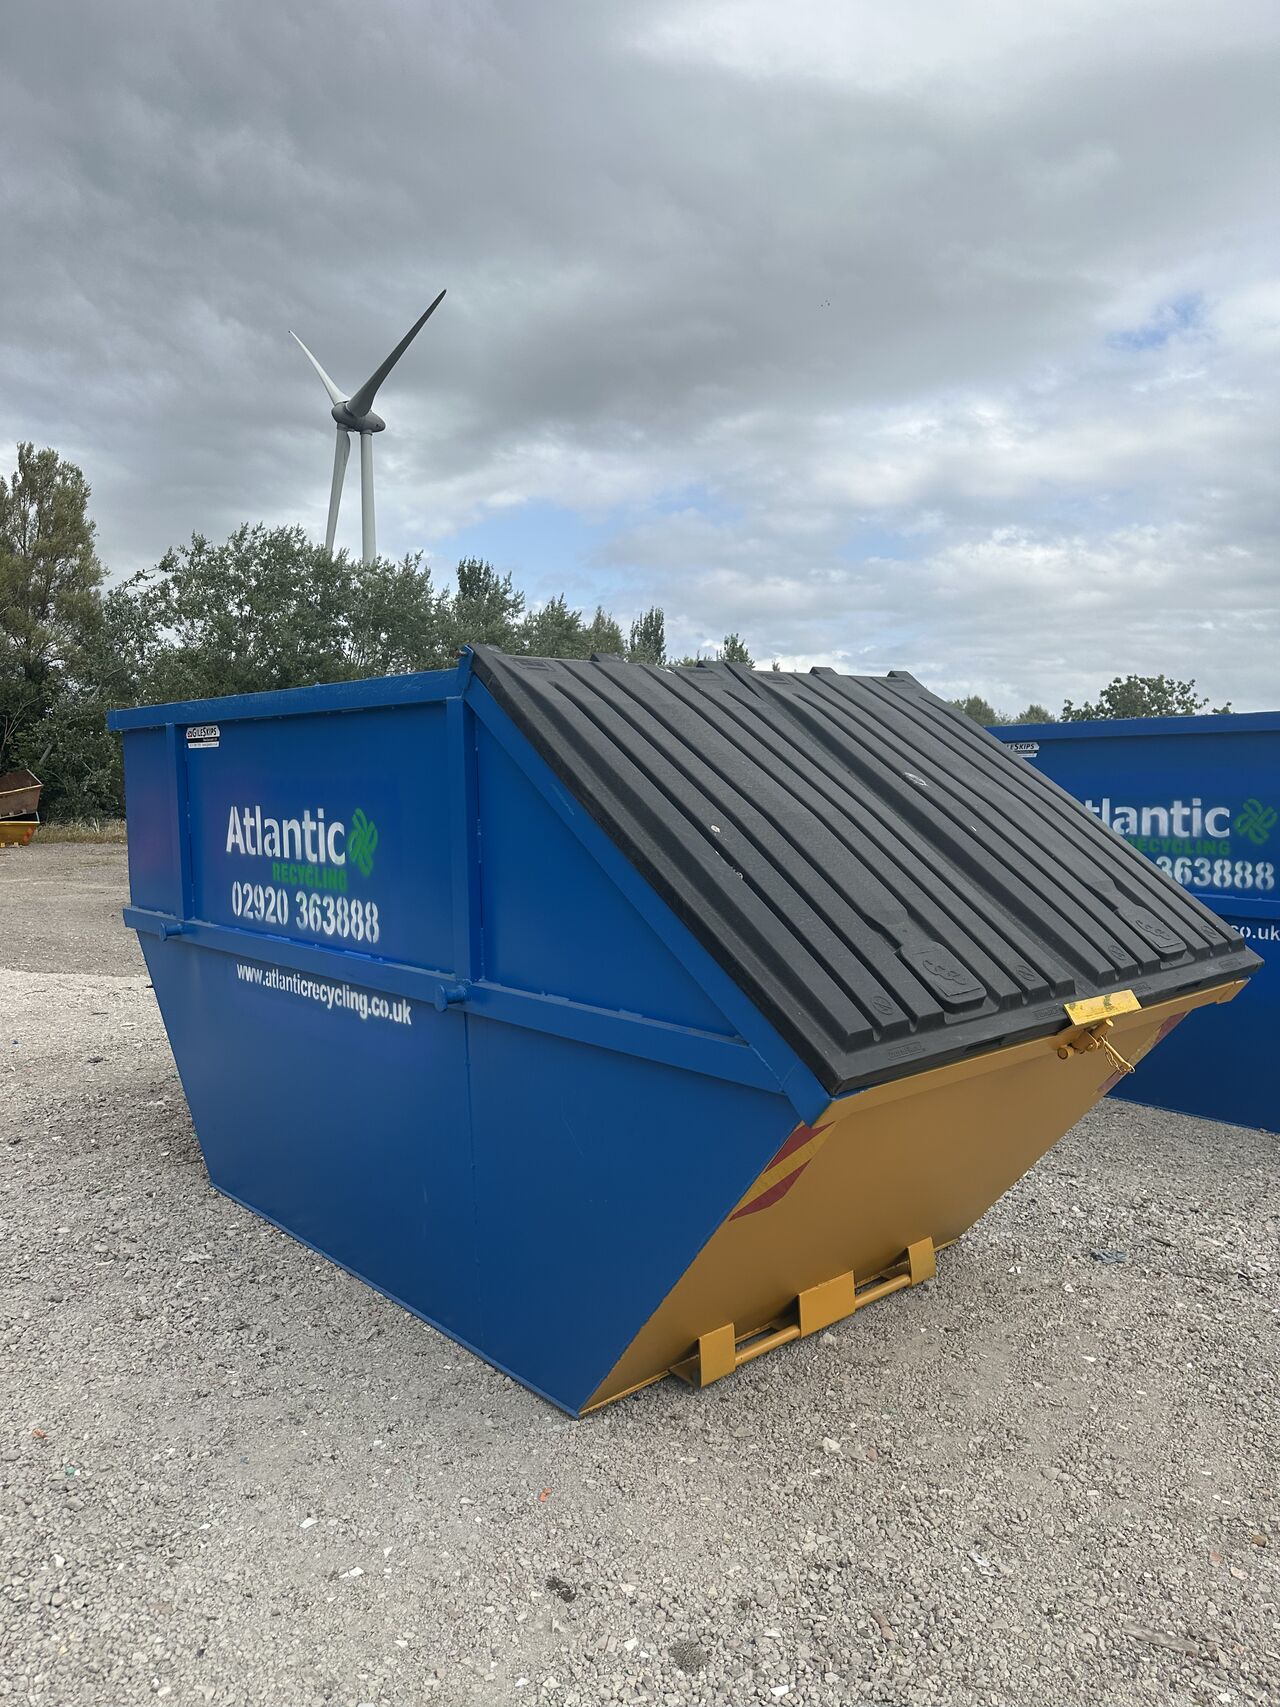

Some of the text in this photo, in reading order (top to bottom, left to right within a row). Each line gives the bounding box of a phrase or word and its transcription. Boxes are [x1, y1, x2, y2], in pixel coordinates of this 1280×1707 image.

[226, 805, 346, 866] Atlantic
[1085, 797, 1231, 839] lantic
[272, 861, 348, 893] RECYCLING
[232, 881, 380, 944] 02920 363888
[236, 963, 412, 1025] www.atlanticrecycling.co.uk
